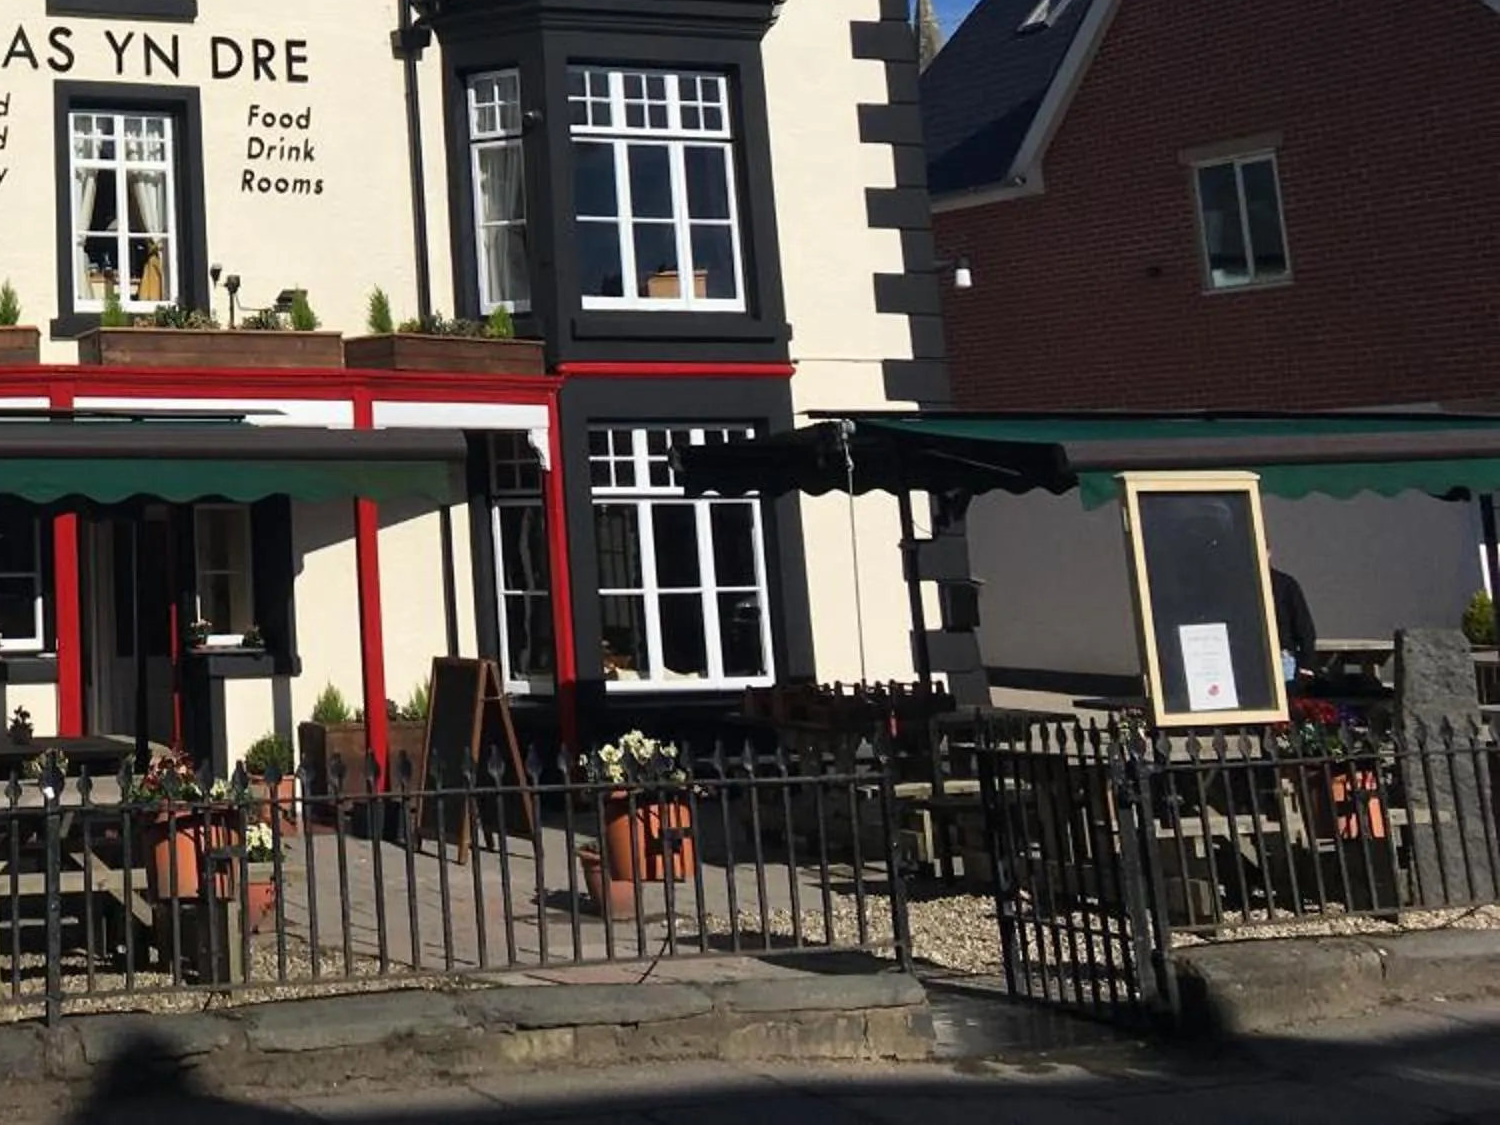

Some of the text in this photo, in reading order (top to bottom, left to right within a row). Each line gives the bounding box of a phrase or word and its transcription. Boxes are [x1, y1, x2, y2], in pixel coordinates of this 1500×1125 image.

[104, 30, 180, 78] YN
[211, 36, 309, 84] DRE
[247, 104, 311, 130] Food
[247, 137, 316, 162] Drink
[241, 168, 324, 195] Rooms
